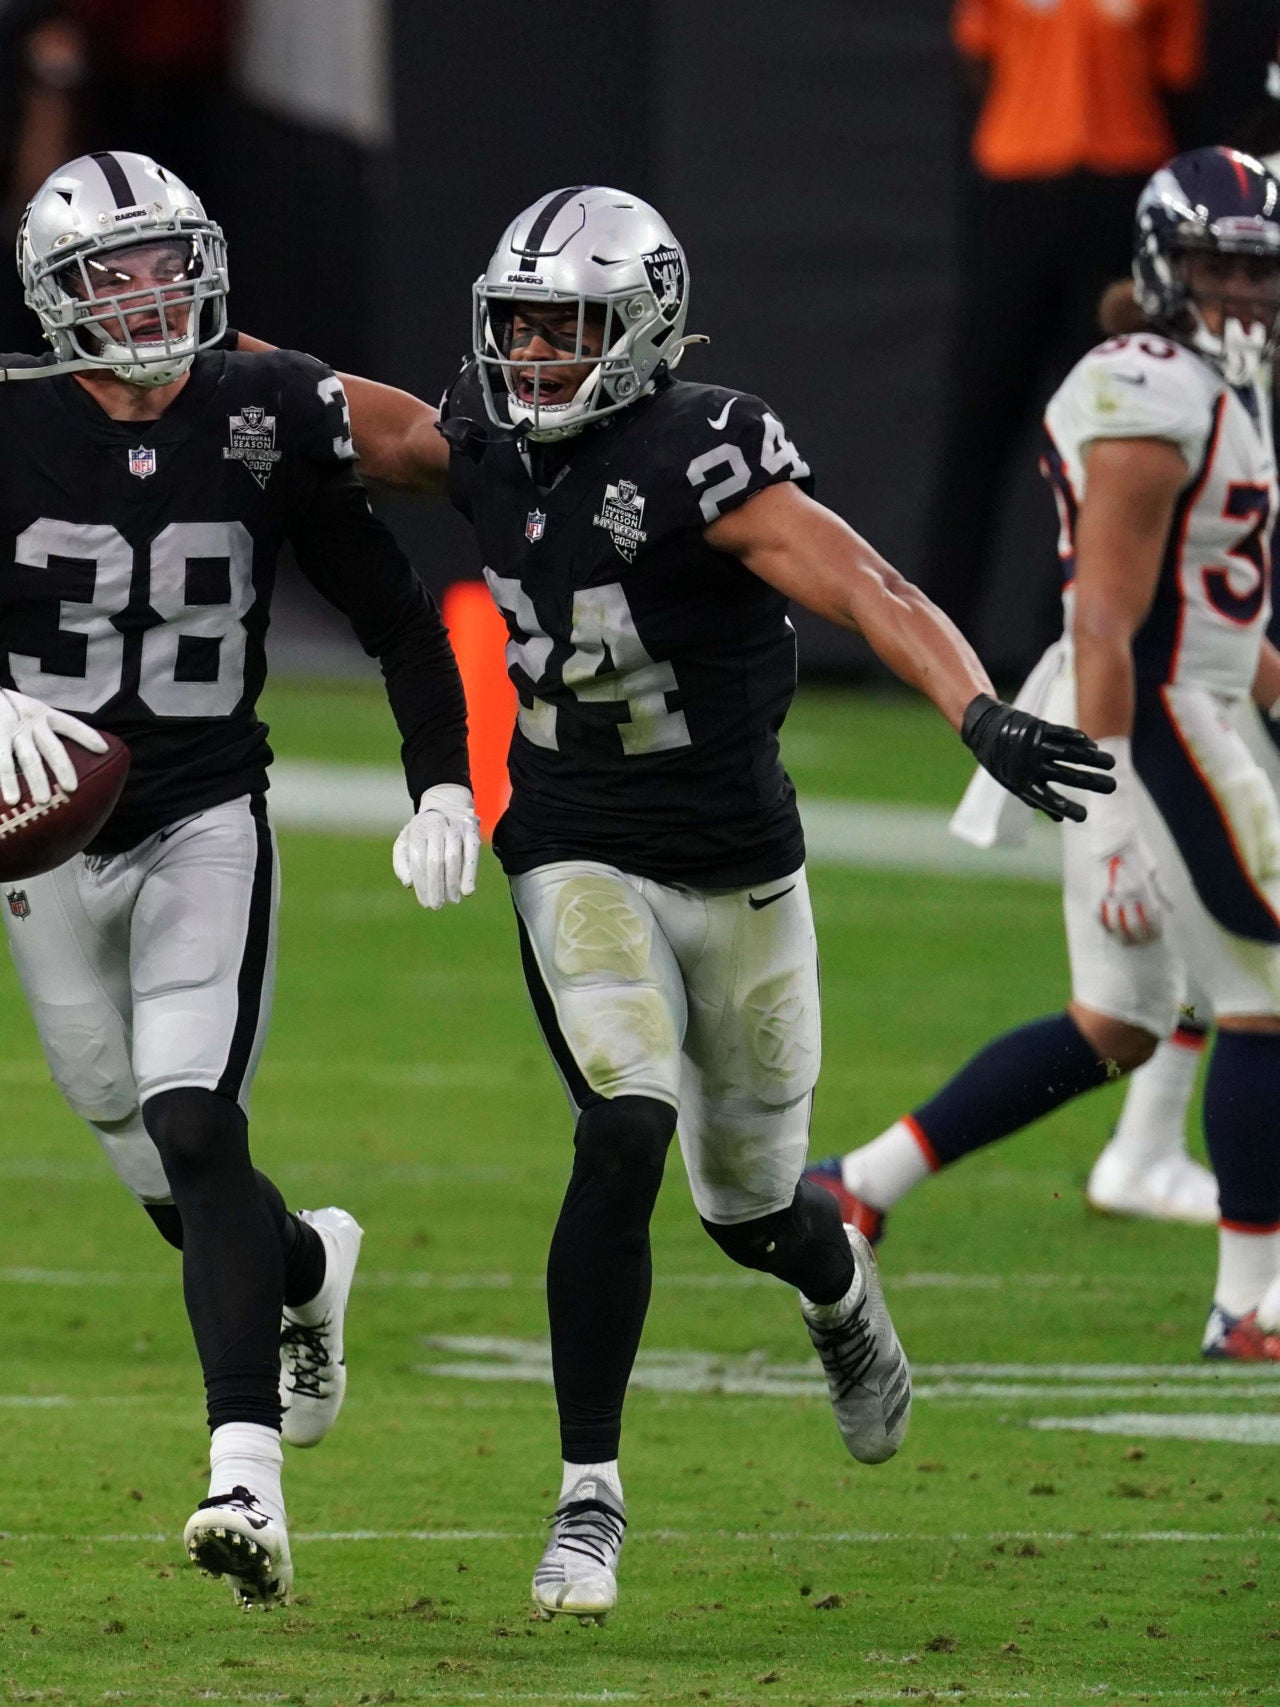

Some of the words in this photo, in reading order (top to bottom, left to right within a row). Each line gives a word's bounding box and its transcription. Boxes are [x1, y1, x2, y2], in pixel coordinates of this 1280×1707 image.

[115, 210, 147, 221] RAIDERS
[647, 250, 679, 264] RAIDERS
[233, 440, 272, 449] SEASON
[248, 461, 272, 471] 2020
[686, 412, 810, 523] 24
[604, 510, 639, 528] SEASON
[606, 505, 638, 520] INAUGURAL
[614, 535, 637, 549] 2020
[8, 516, 256, 717] 38
[482, 565, 692, 756] 24
